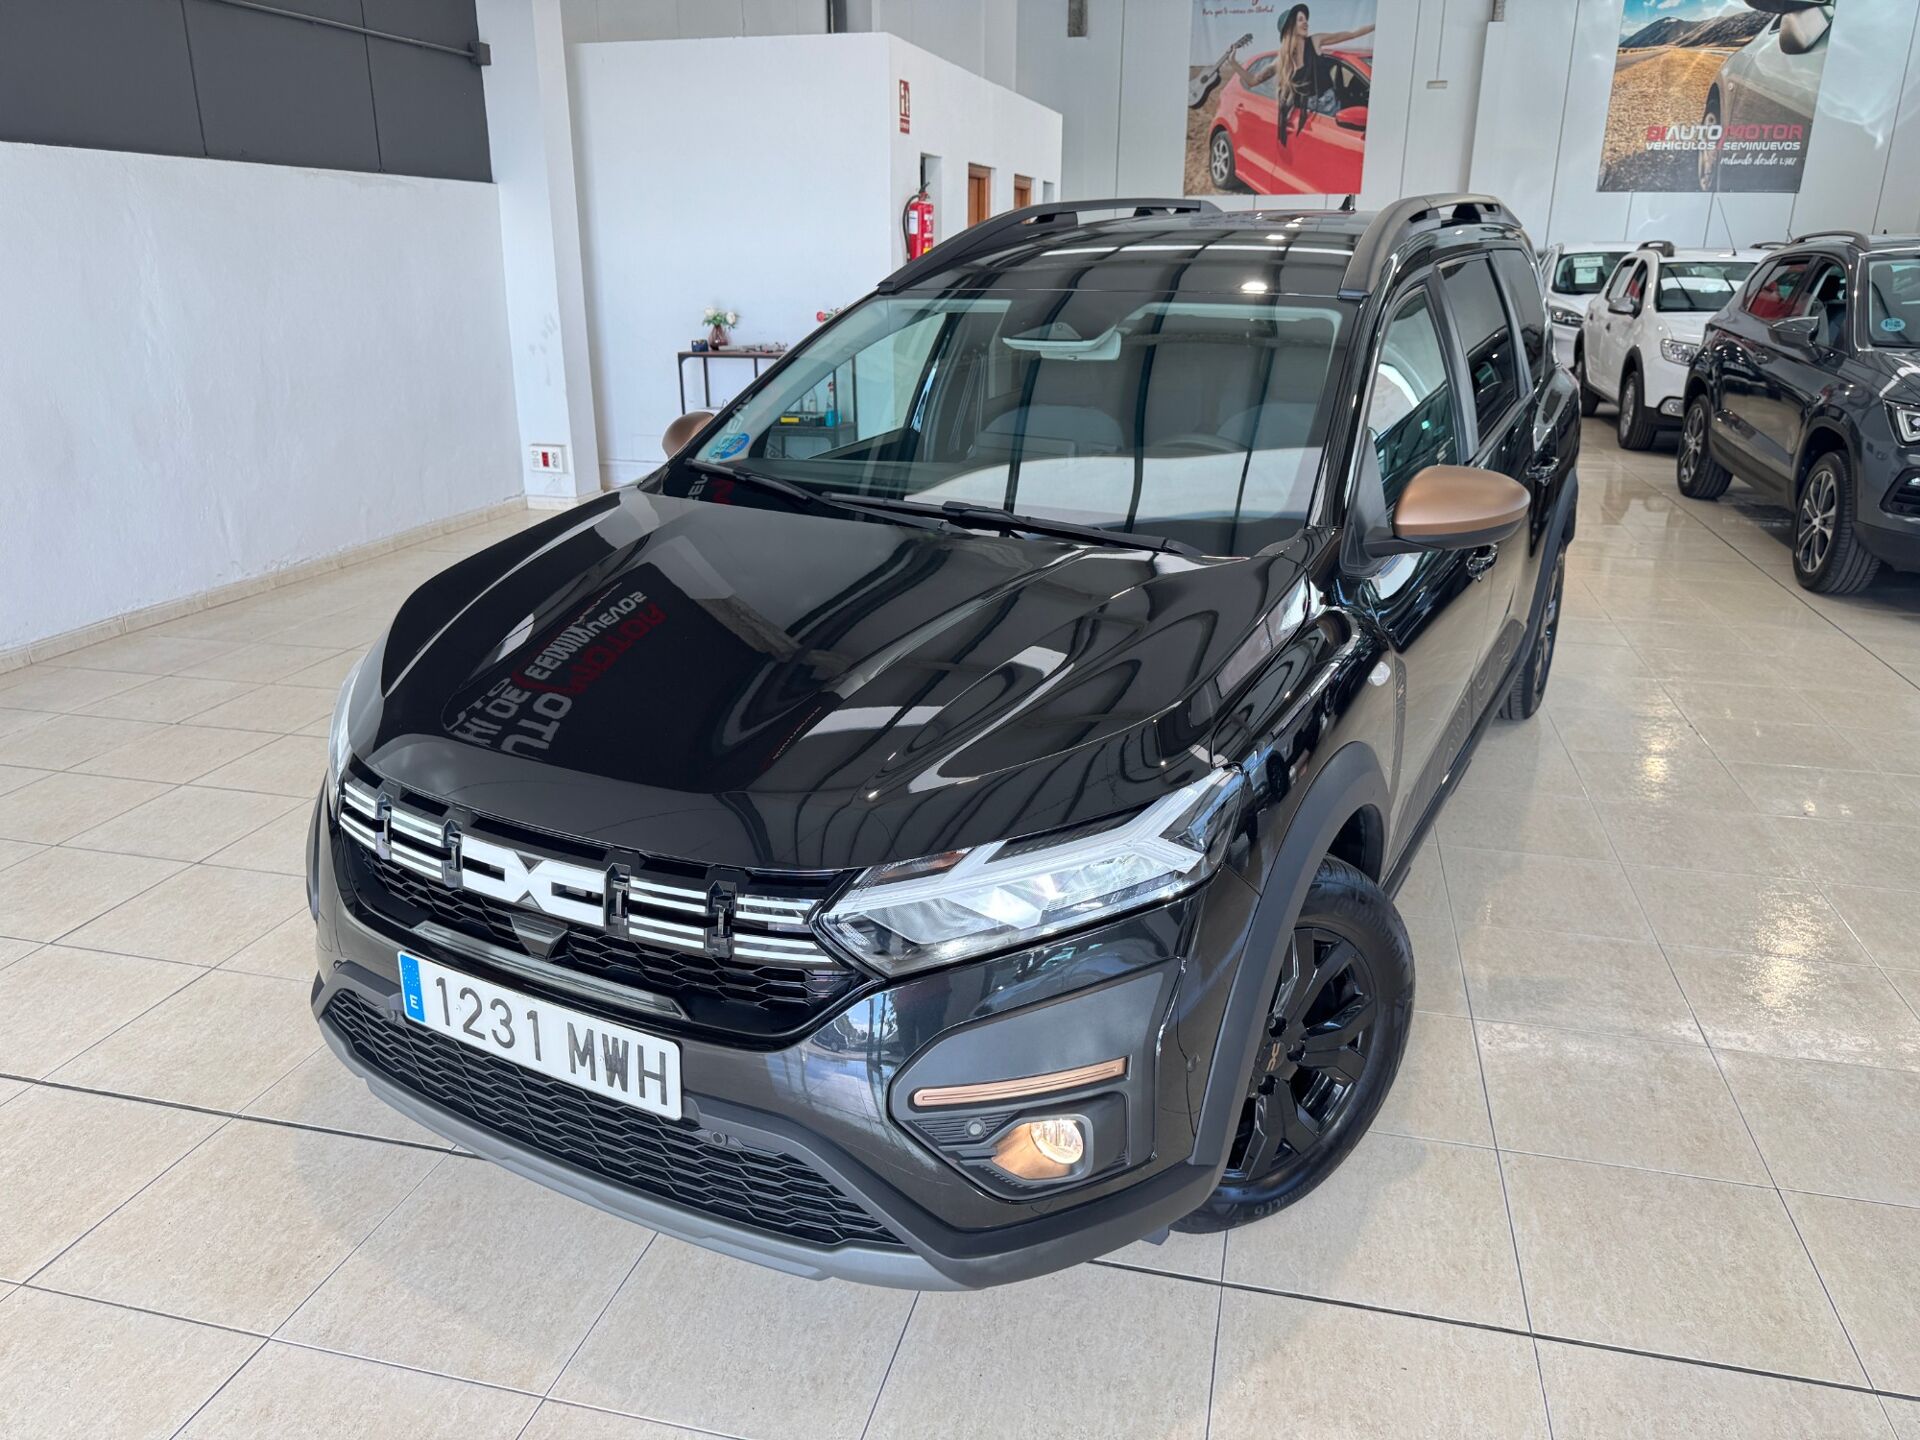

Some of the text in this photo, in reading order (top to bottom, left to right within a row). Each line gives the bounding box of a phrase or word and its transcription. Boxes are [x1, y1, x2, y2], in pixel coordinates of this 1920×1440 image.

[1645, 141, 1801, 151] VEHICULOS SEMINUEVOS
[409, 993, 419, 1010] E
[435, 976, 668, 1107] 1231 MWH
